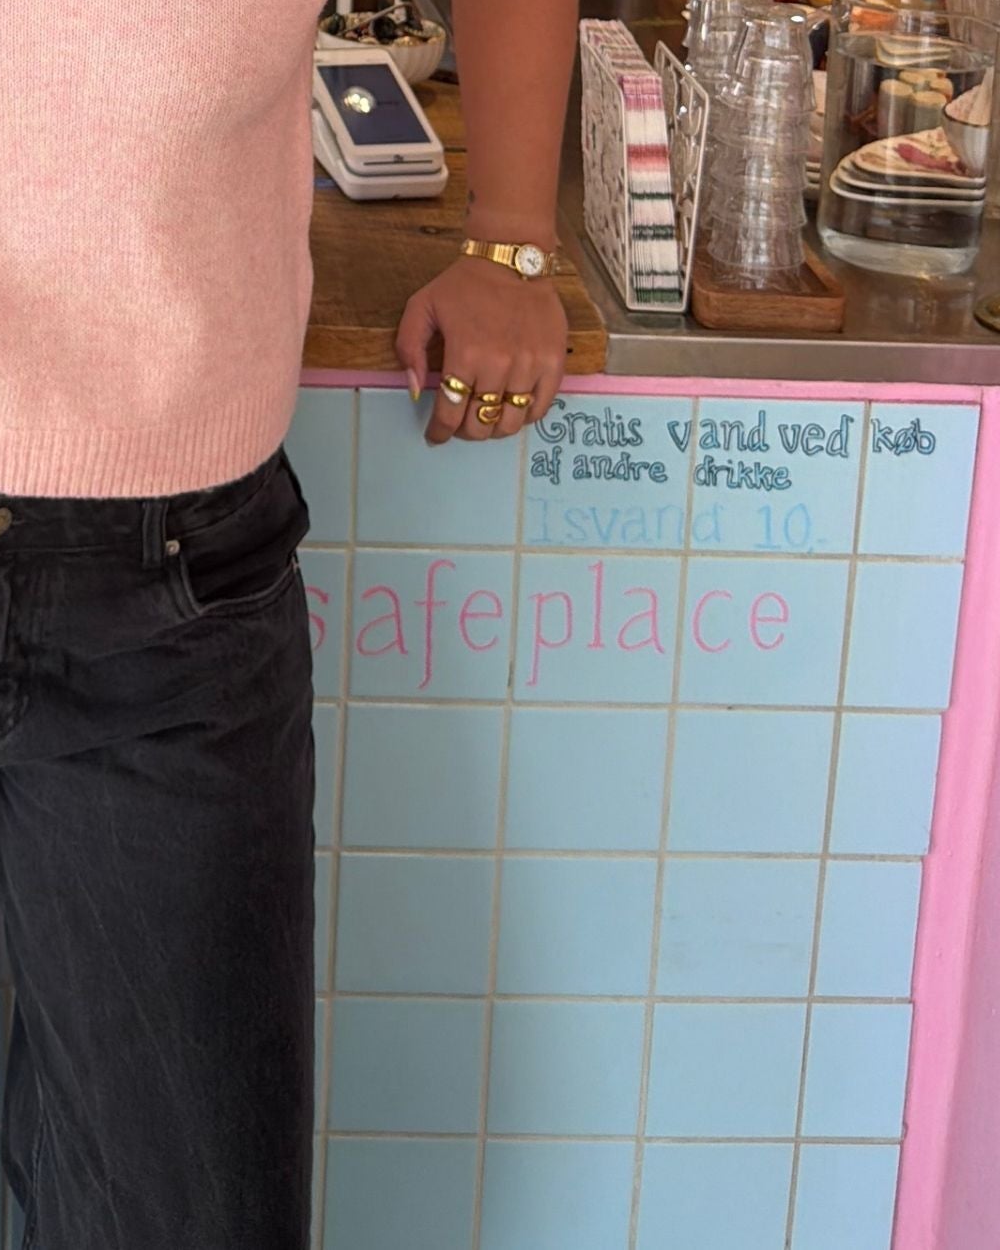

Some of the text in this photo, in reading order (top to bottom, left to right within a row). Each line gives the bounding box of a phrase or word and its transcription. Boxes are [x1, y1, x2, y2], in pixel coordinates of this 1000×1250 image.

[534, 398, 937, 458] Gratis vand ved køb
[530, 445, 793, 491] af andre drikke
